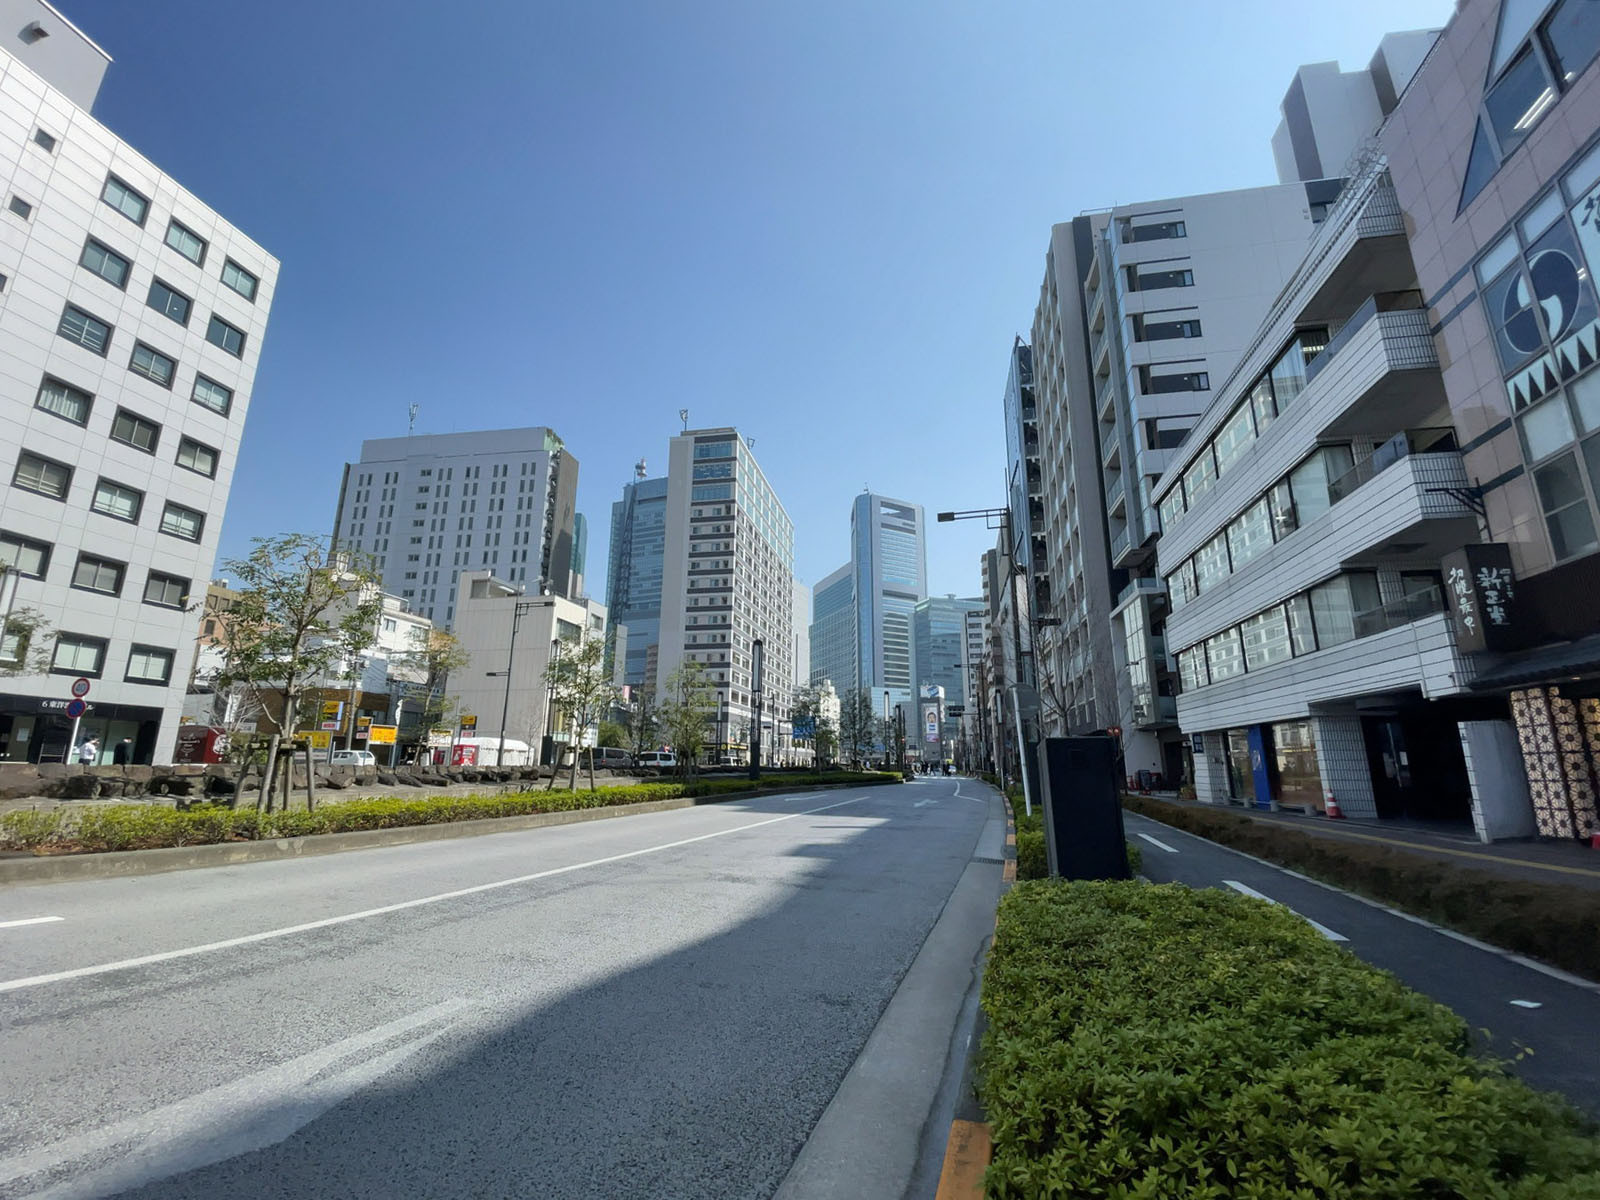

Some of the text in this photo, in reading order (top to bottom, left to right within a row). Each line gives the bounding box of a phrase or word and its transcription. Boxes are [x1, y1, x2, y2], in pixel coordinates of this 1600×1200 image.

[1477, 567, 1510, 625] 新正堂
[75, 683, 87, 693] 40
